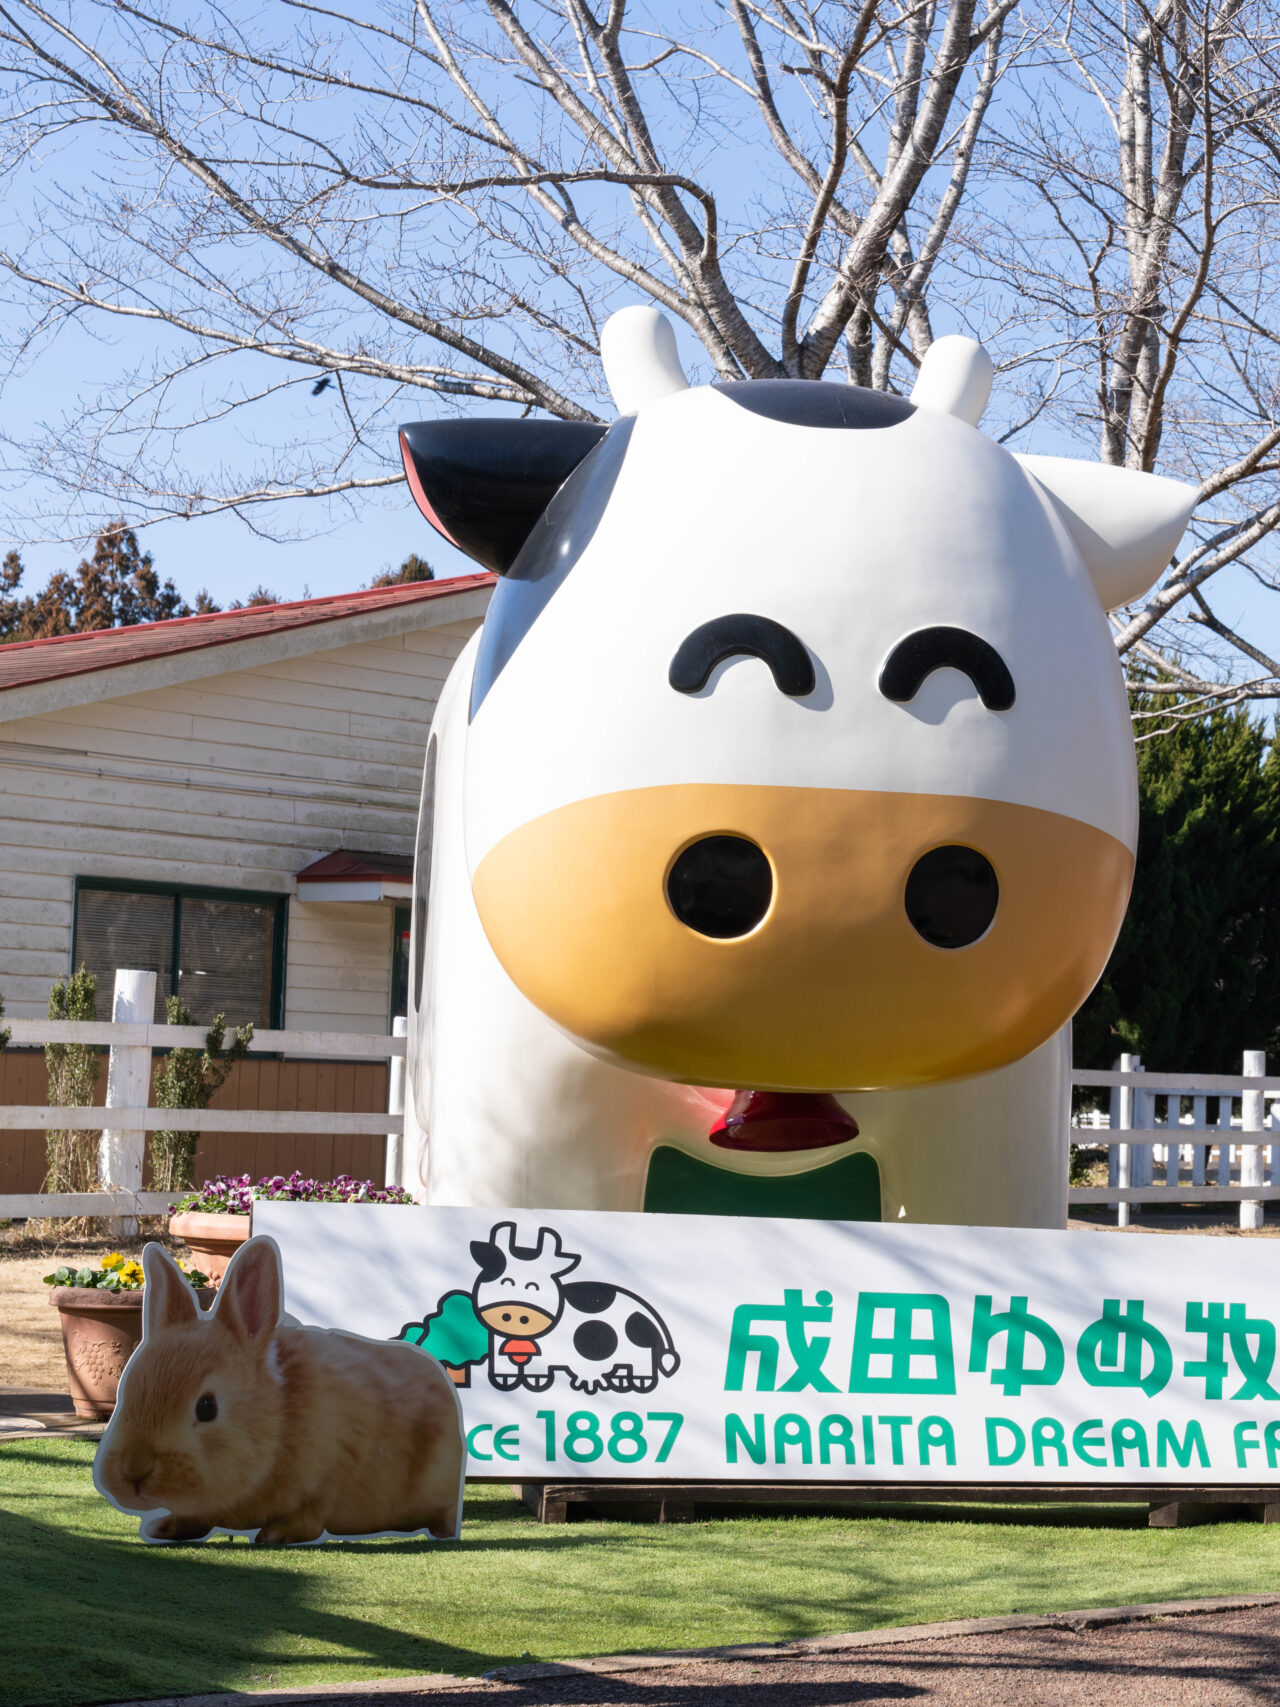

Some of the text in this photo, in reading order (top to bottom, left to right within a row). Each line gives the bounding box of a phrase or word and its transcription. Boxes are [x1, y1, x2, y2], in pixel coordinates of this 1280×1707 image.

[536, 1410, 684, 1464] 1887
[725, 1413, 956, 1466] NARITA
[985, 1417, 1212, 1469] DREAM
